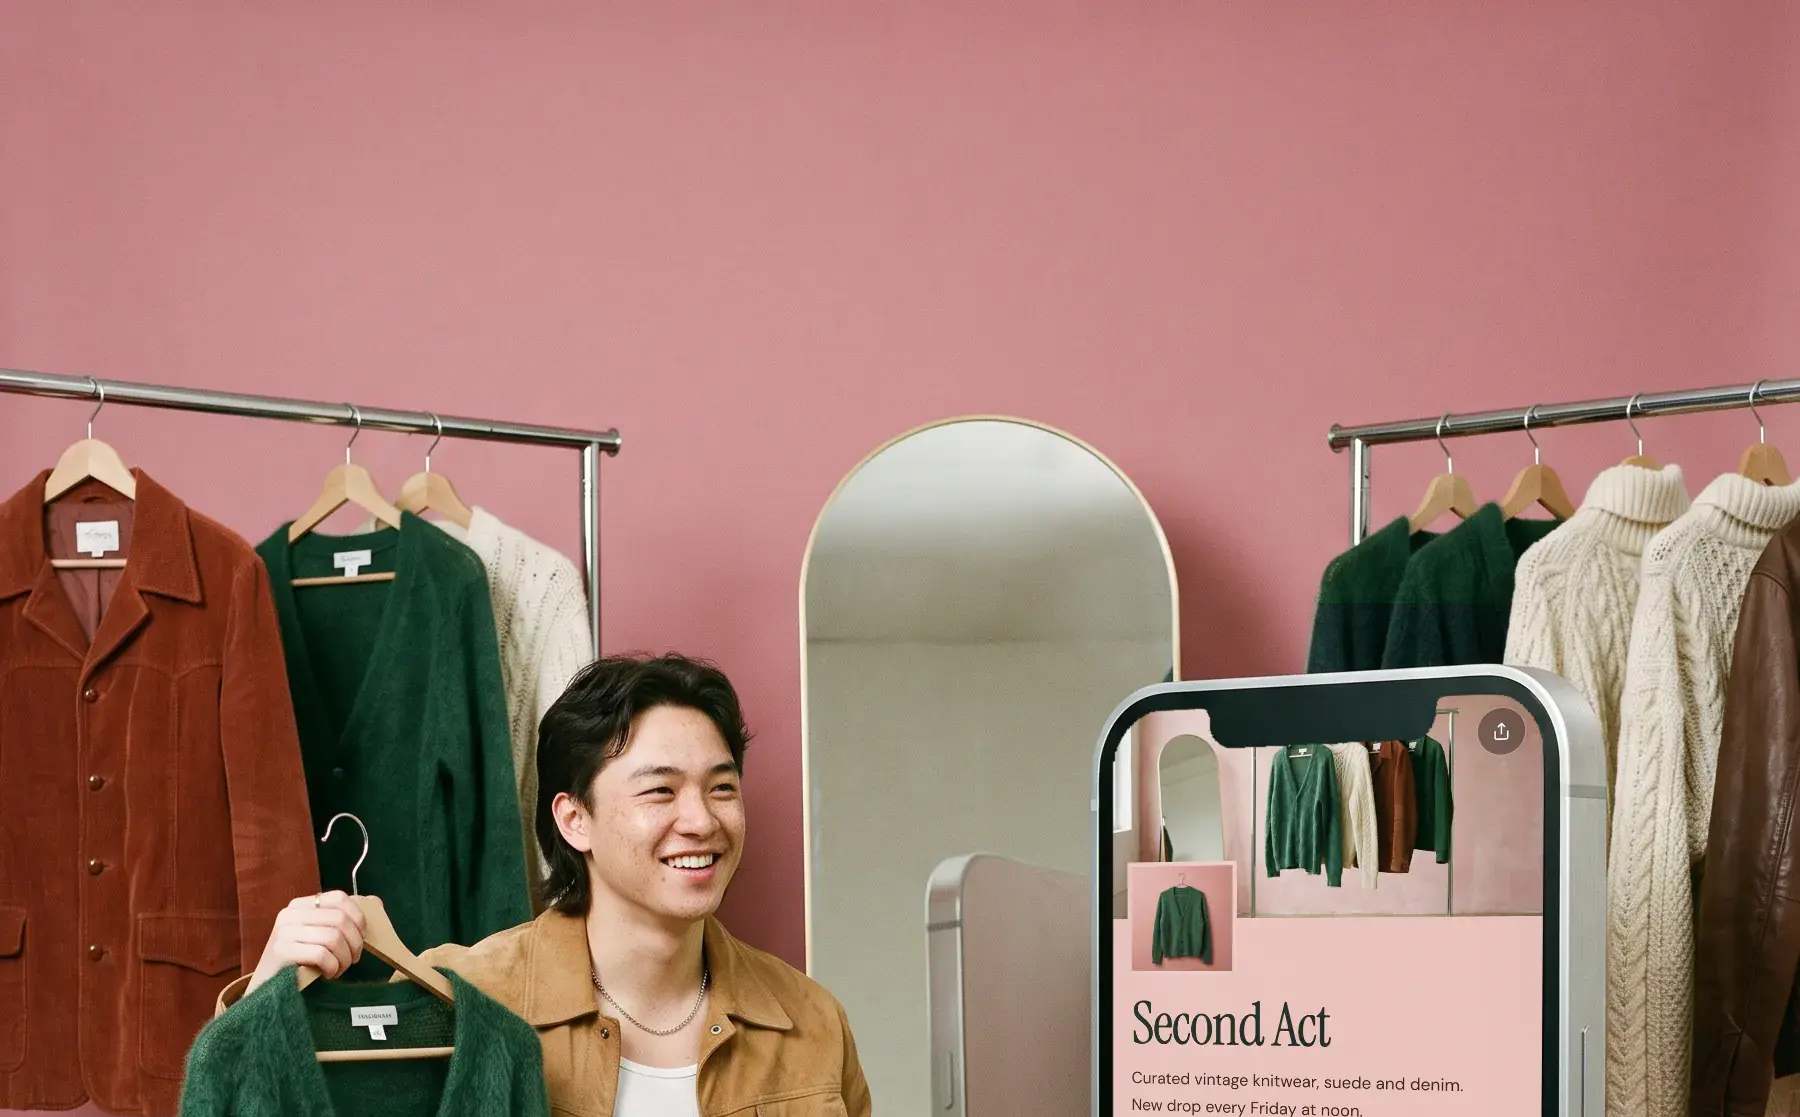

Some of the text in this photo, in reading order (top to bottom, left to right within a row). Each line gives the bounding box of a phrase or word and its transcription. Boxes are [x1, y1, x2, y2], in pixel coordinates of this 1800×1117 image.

[1132, 999, 1332, 1048] Second Act
[1131, 1071, 1464, 1092] Curated vintage knitwear, suede and denim.
[1131, 1097, 1163, 1112] New
[1166, 1098, 1202, 1117] drop
[1205, 1103, 1247, 1117] every
[1301, 1104, 1317, 1116] at
[1321, 1106, 1363, 1117] noon.
